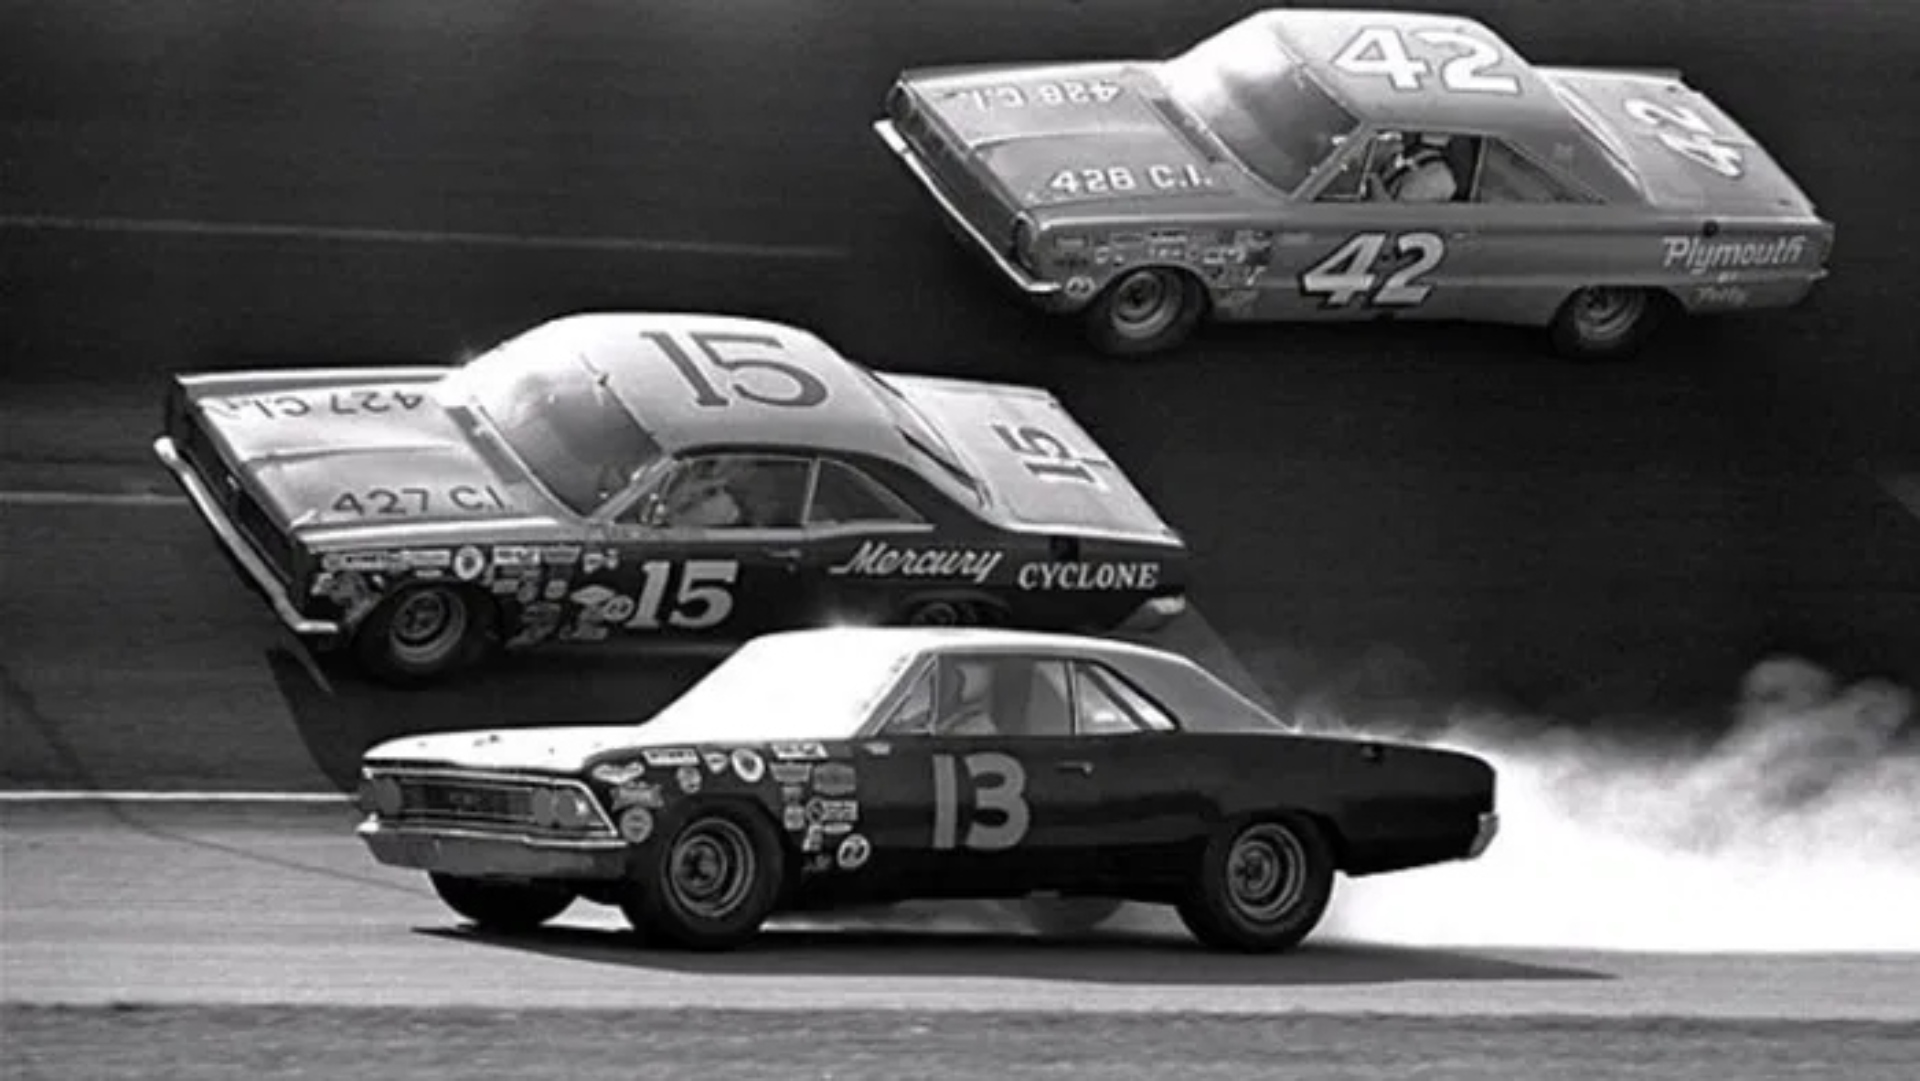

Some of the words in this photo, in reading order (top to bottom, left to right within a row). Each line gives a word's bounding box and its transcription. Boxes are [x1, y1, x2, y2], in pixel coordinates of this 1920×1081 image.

[1330, 24, 1523, 95] 42
[1621, 99, 1744, 178] 42
[1301, 230, 1446, 307] 42
[1661, 234, 1806, 275] Plymouth
[326, 391, 424, 417] 427
[640, 330, 828, 408] 15
[996, 421, 1098, 484] 15
[331, 487, 430, 516] 427
[625, 560, 739, 630] 15
[829, 541, 1004, 582] Mercury
[1017, 562, 1159, 591] CYCLONE
[932, 752, 1031, 850] 13
